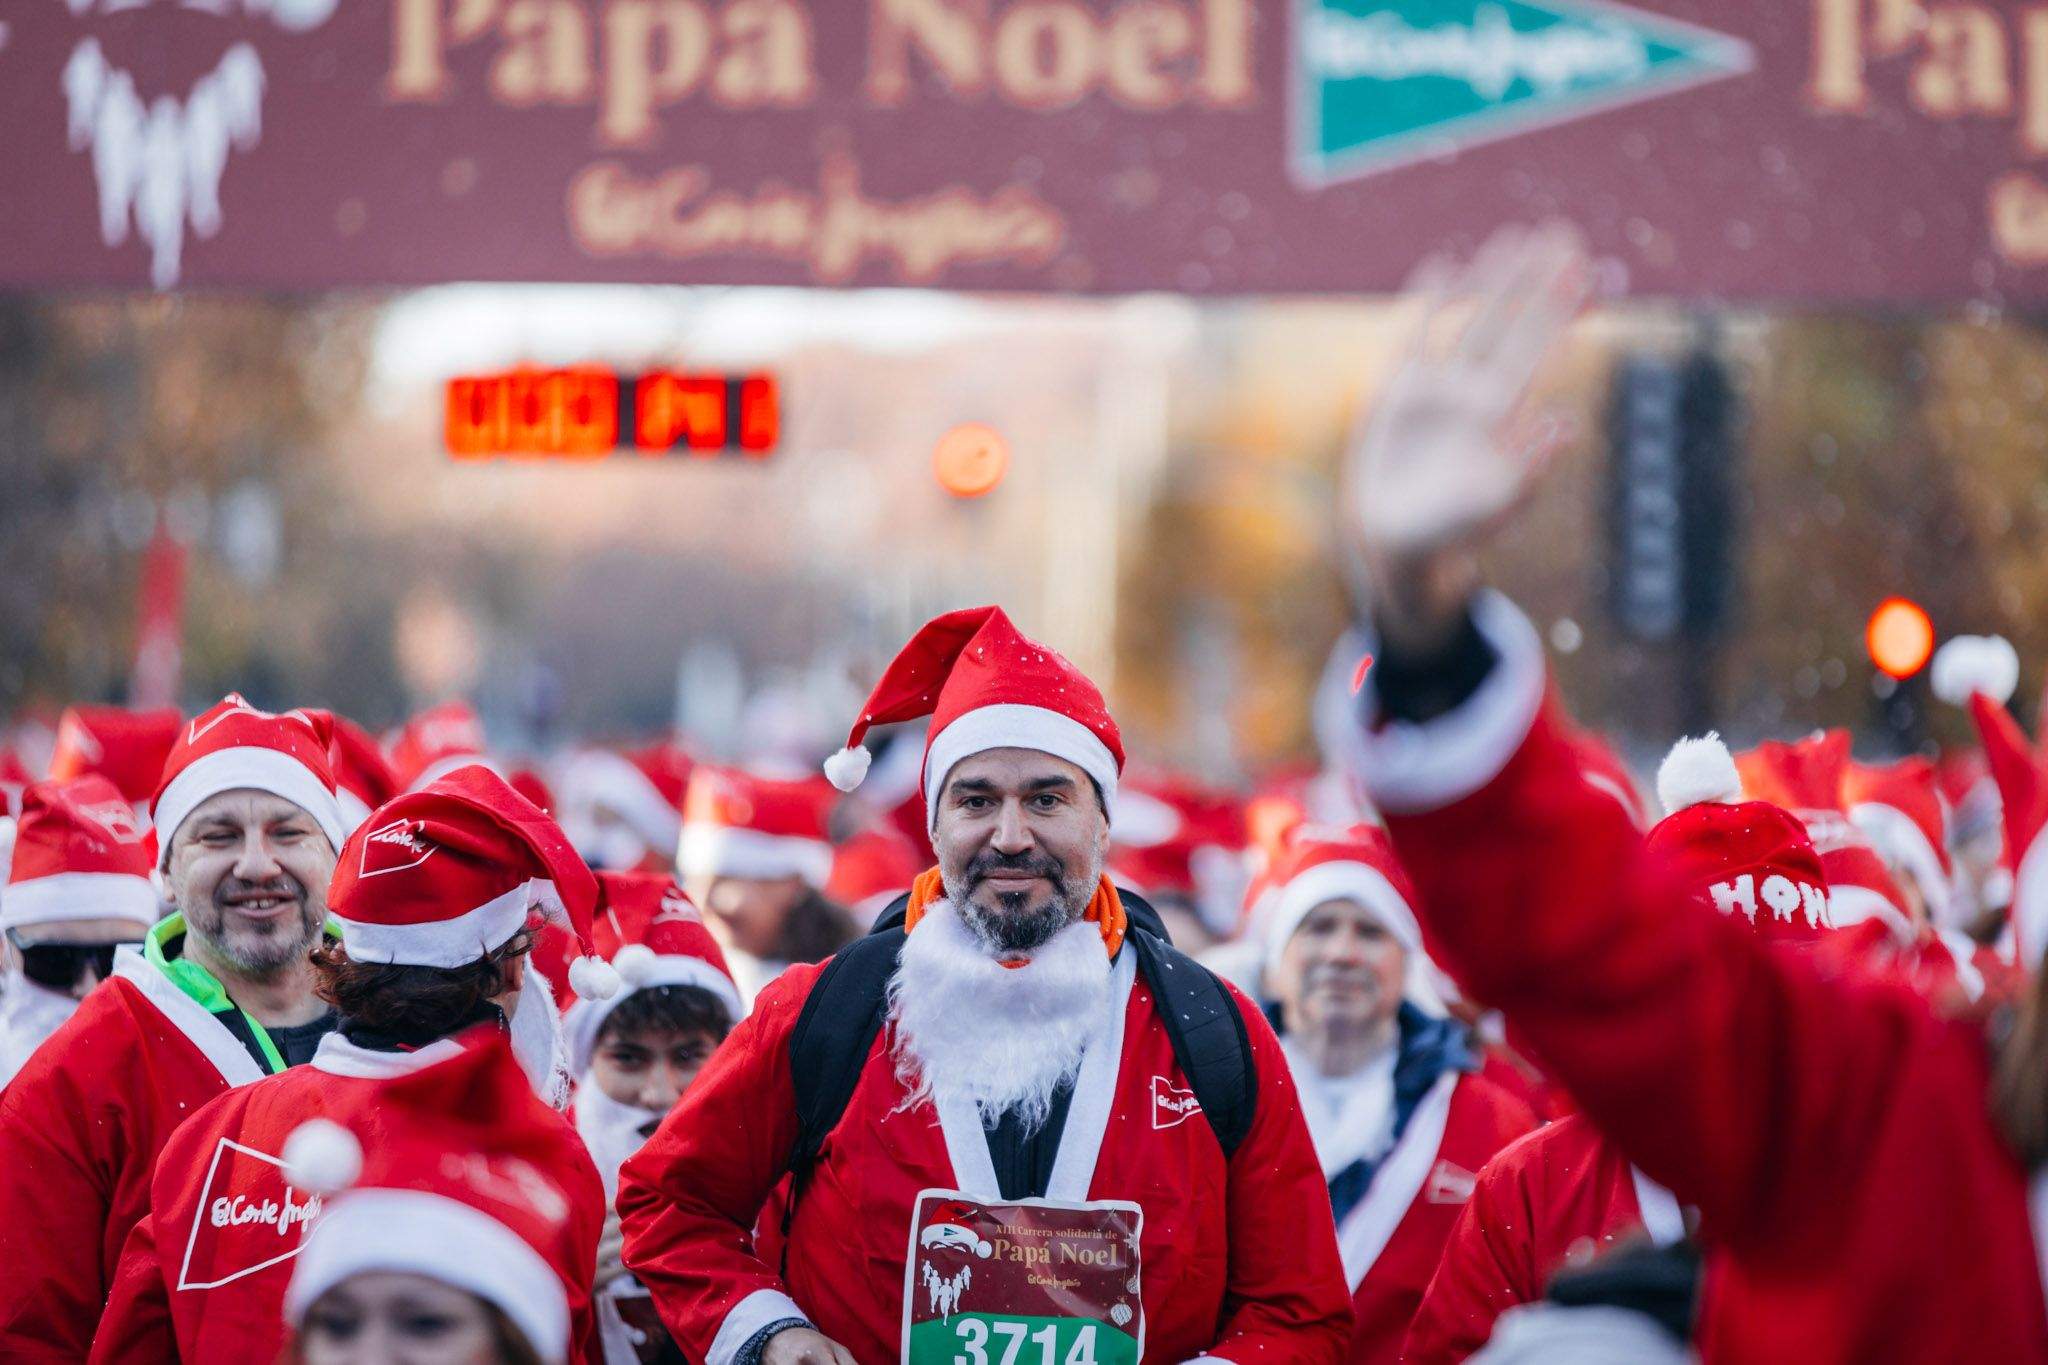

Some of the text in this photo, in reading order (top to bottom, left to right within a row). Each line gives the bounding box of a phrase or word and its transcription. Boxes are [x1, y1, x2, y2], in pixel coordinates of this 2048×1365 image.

[868, 0, 1256, 108] Noel
[211, 1196, 231, 1228] El
[230, 1194, 279, 1226] Corte
[1016, 1224, 1053, 1238] Carrera
[1055, 1228, 1102, 1240] solidaria
[1104, 1229, 1118, 1240] de
[993, 1238, 1118, 1269] Papá Noel
[954, 1317, 1099, 1365] 3714
